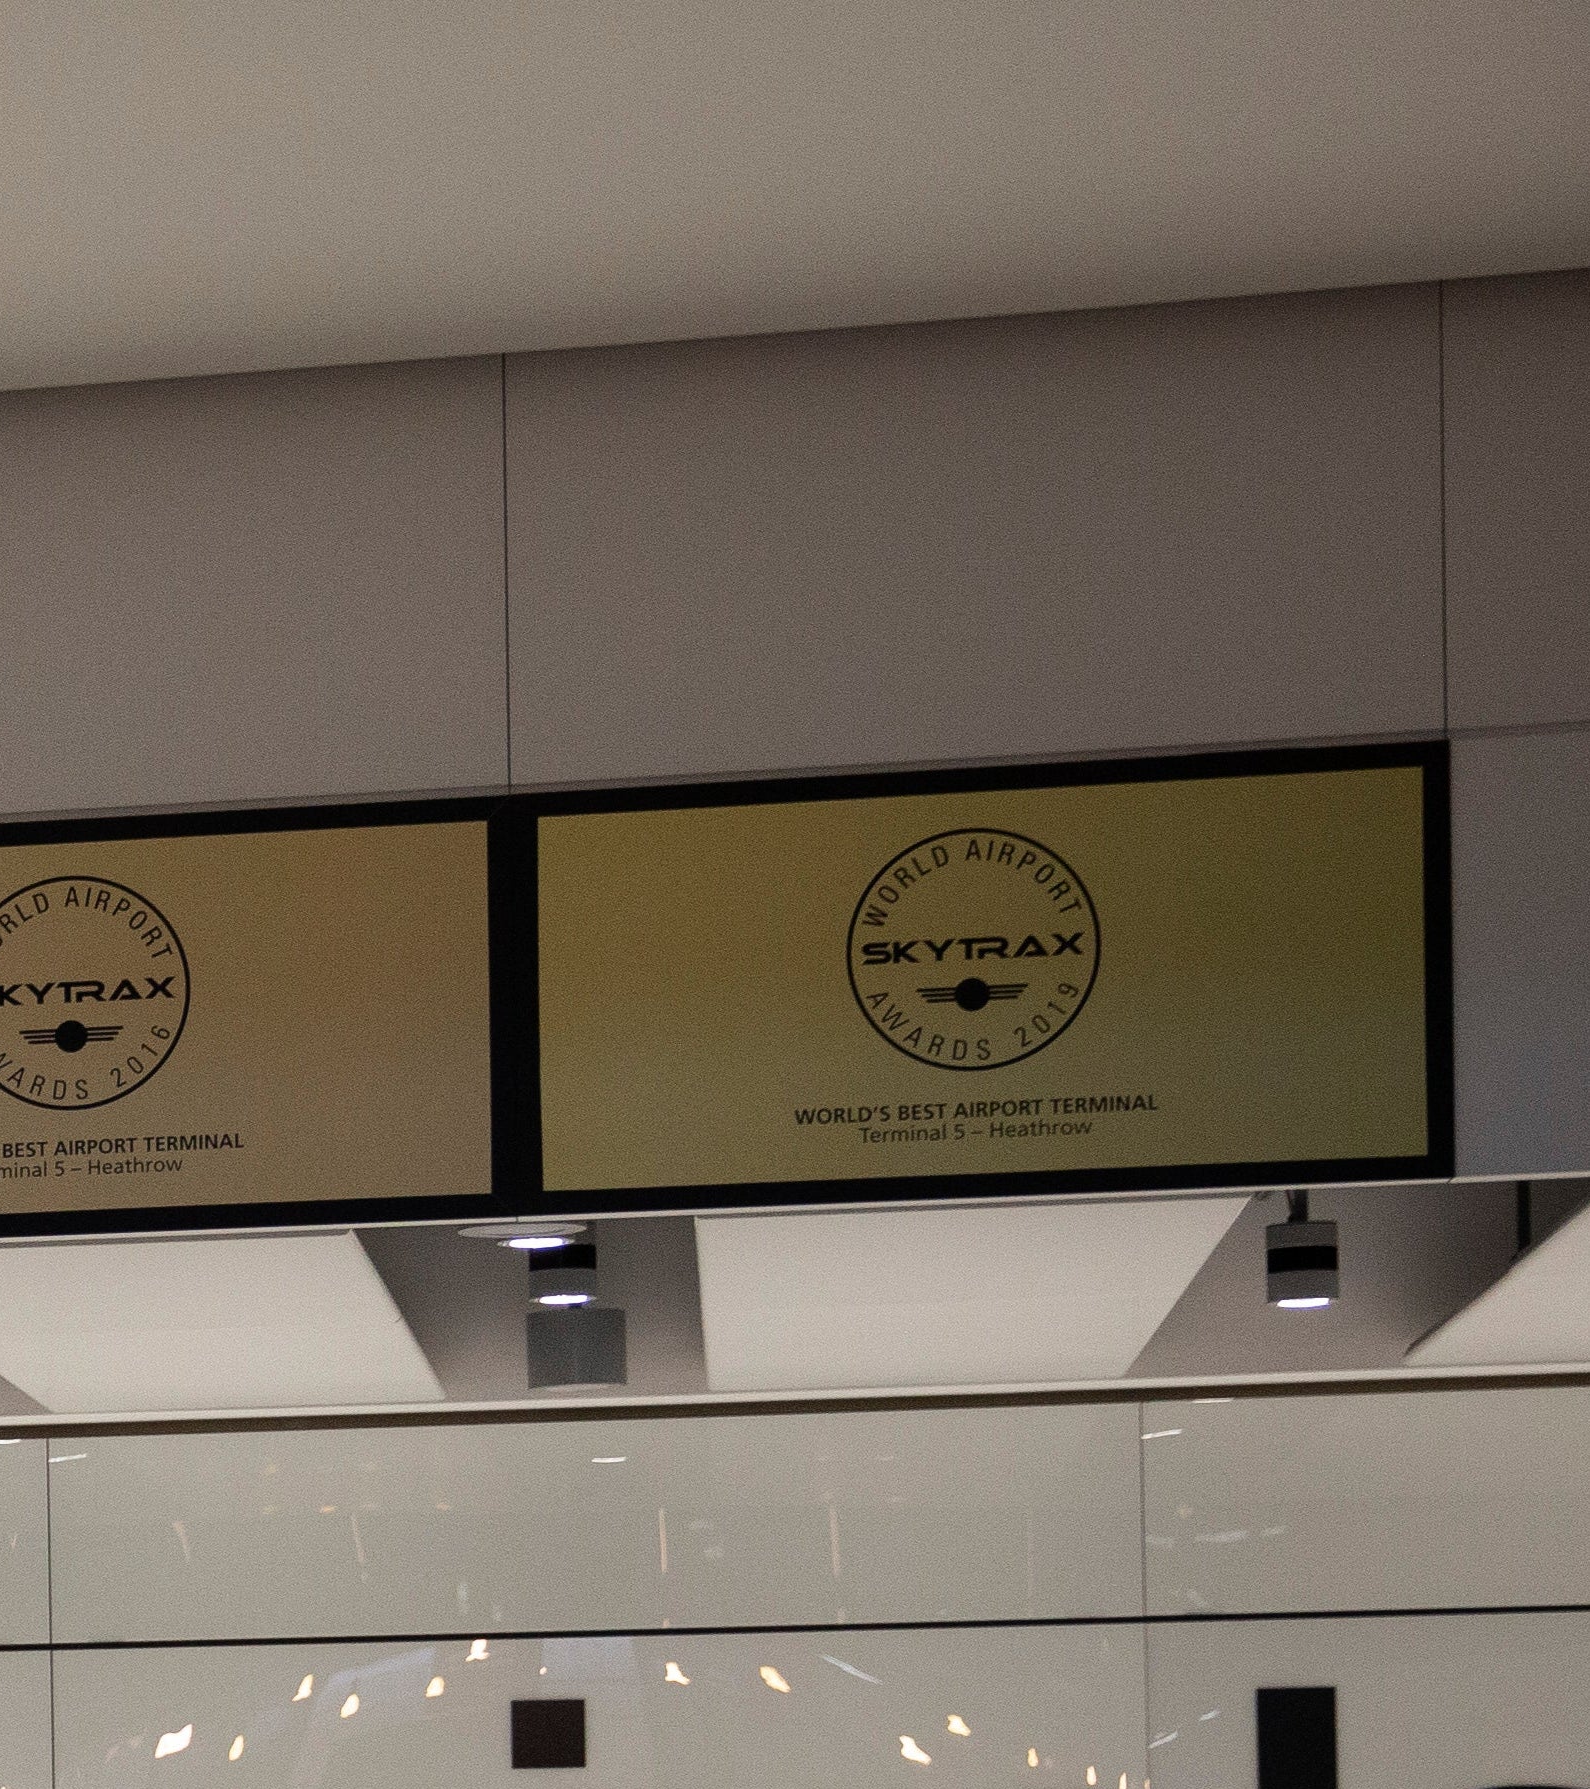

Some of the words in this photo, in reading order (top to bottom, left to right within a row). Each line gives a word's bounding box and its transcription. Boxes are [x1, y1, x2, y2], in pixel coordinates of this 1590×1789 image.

[863, 845, 949, 928] WORLD
[965, 839, 1082, 913] AIRPORT
[64, 886, 173, 959] AIRPORT
[862, 932, 1085, 965] SKYTRAX
[867, 992, 990, 1061] AWARDS
[1014, 983, 1079, 1048] 2019
[110, 1025, 170, 1088] 2016
[794, 1106, 890, 1125] WORLD'S
[897, 1103, 947, 1121] BEST
[954, 1099, 1042, 1118] AIRPORT
[1051, 1095, 1158, 1115] TERMINAL
[2, 1142, 48, 1158] BEST
[54, 1138, 136, 1156] AIRPORT
[143, 1133, 244, 1152] TERMINAL
[859, 1125, 946, 1144] Terminal
[954, 1124, 965, 1140] 5
[990, 1120, 1093, 1139] Heathrow
[55, 1162, 65, 1177] 5
[88, 1157, 182, 1176] Heathrow
